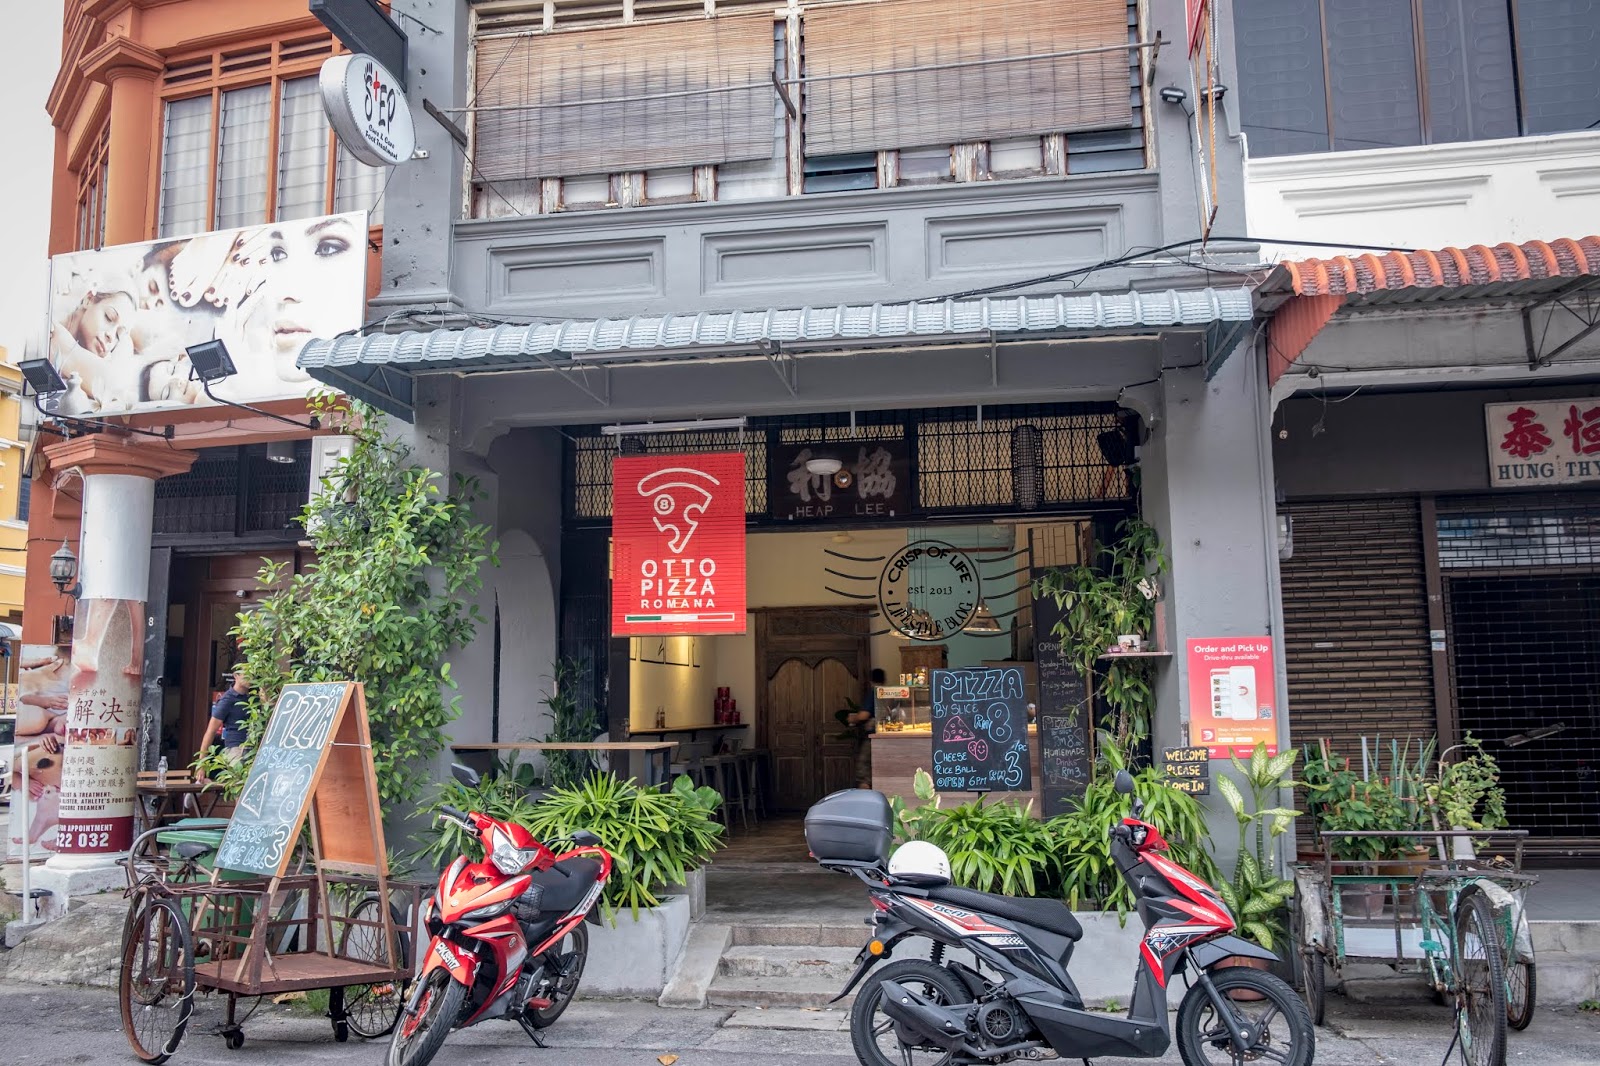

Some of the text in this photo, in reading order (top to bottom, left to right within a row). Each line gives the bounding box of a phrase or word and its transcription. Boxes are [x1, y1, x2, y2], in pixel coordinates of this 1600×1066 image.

[1498, 463, 1554, 480] HUNG
[796, 503, 885, 517] HEAP LEE
[641, 558, 716, 577] OTTO
[641, 578, 715, 596] PIZZA
[640, 598, 715, 609] ROMANA
[148, 616, 154, 627] 8
[1194, 644, 1268, 653] Order and Pick Up
[933, 669, 1023, 704] PIZZA
[74, 697, 123, 725] 解决
[951, 703, 979, 715] SLICE
[266, 690, 339, 750] PIZZA
[987, 702, 1012, 743] 8
[934, 750, 967, 764] CHEESE
[1044, 748, 1085, 758] HOMEMADE
[1165, 749, 1207, 761] WELCOME
[934, 764, 977, 775] RICE BALL
[1004, 751, 1023, 786] 3
[1166, 764, 1201, 776] PLEASE
[937, 776, 987, 787] OPEN 6PM
[67, 824, 113, 832] APPOINTMENT
[78, 832, 109, 848] 032
[264, 823, 291, 868] 3
[1192, 905, 1217, 920] HONDA
